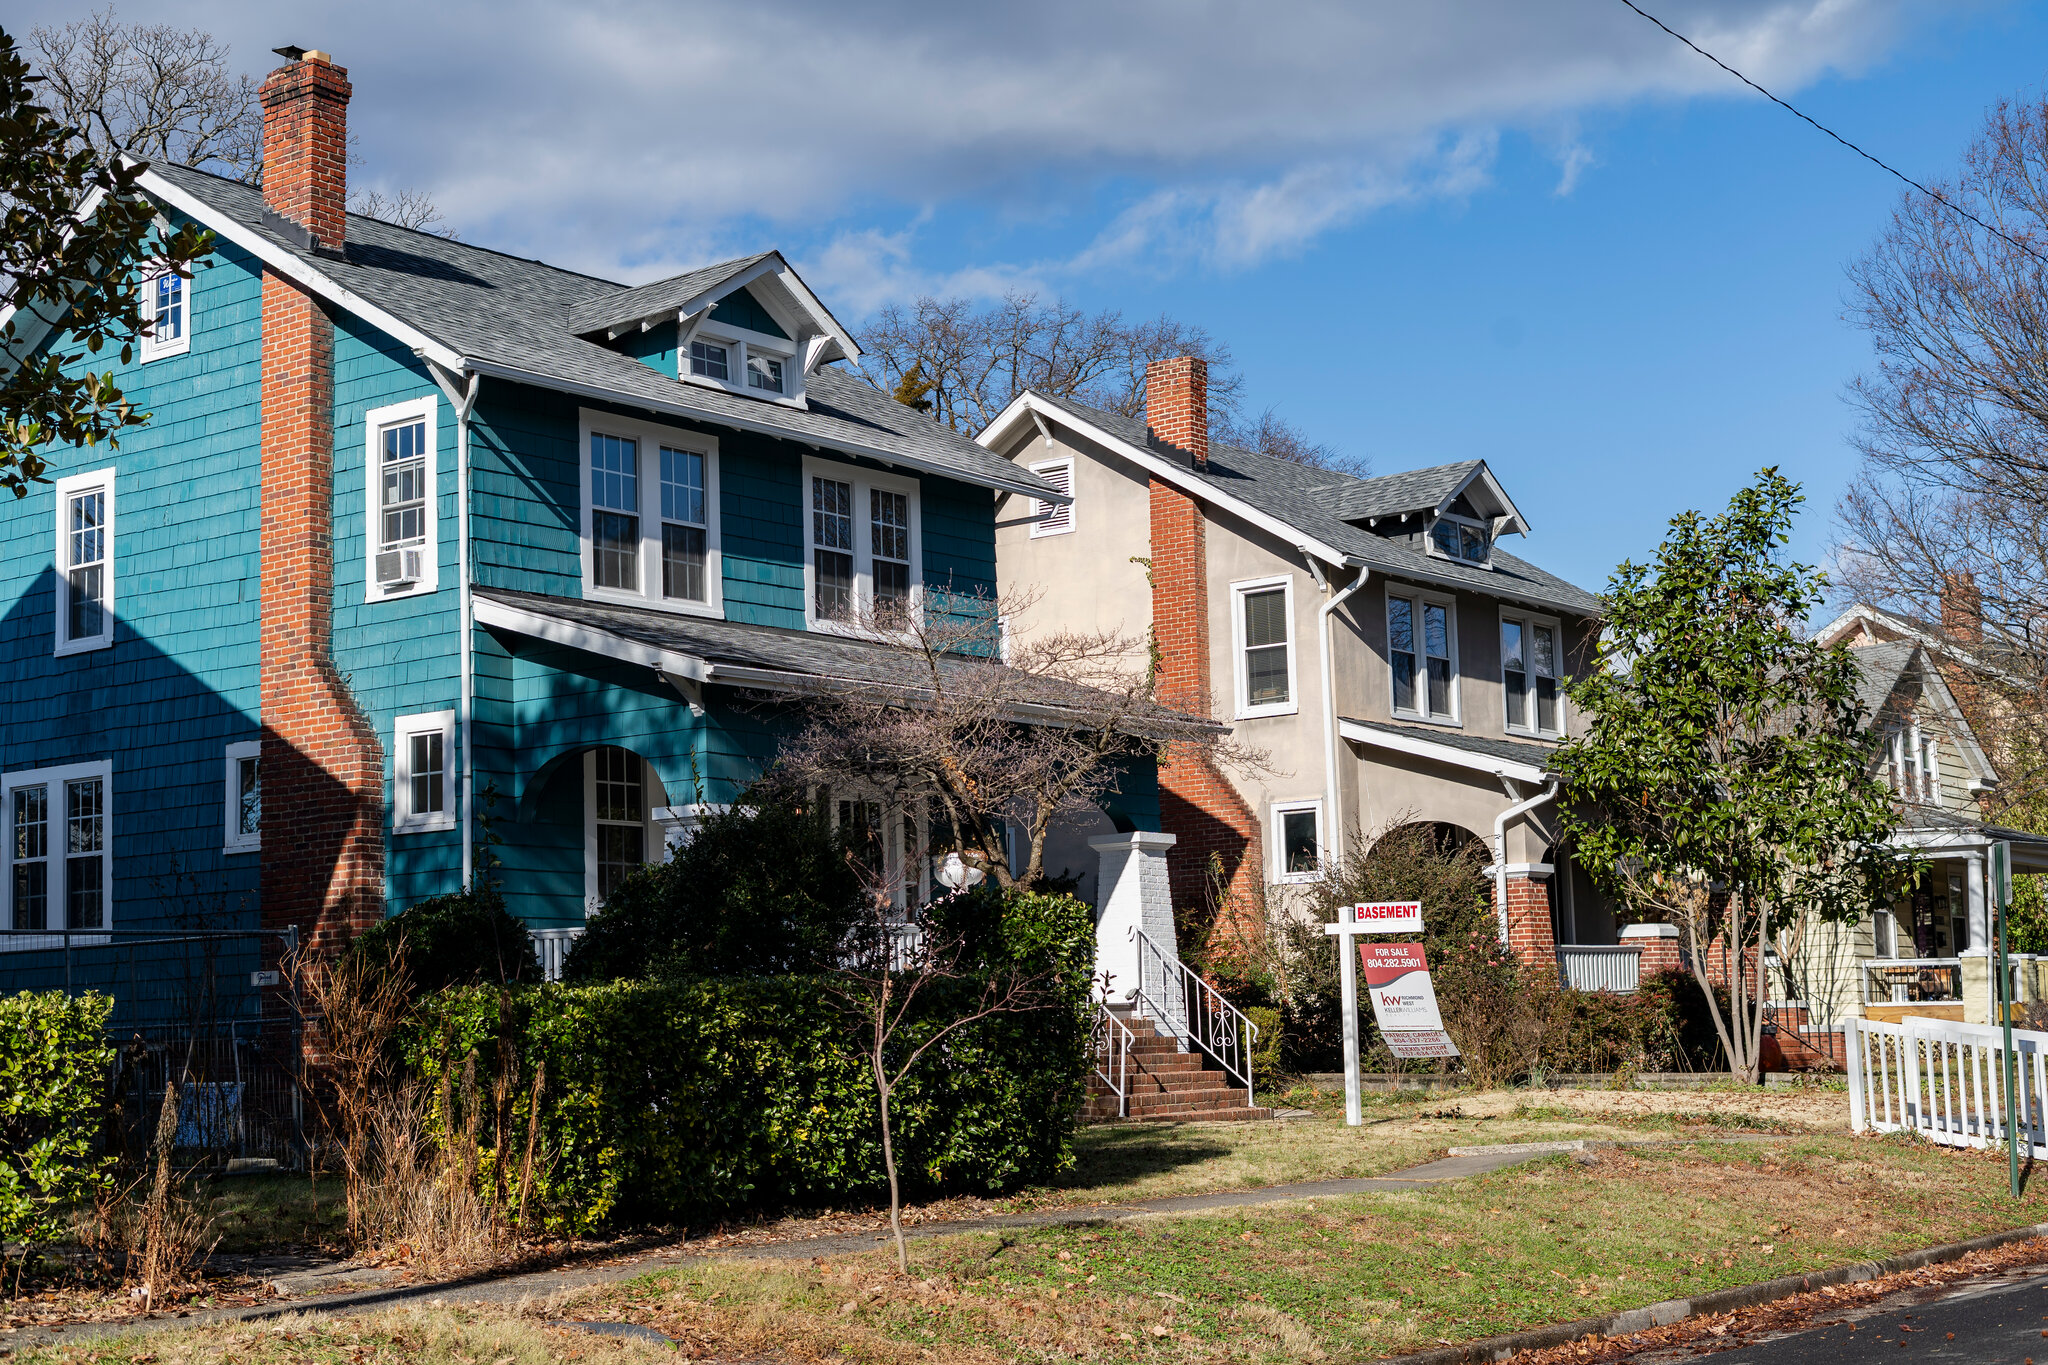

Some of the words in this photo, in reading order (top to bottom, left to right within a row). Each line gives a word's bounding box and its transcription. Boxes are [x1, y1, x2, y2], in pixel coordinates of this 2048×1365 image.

[1357, 905, 1418, 919] BASEMENT
[1375, 948, 1390, 956] FOR
[1390, 948, 1409, 956] SALE
[1367, 958, 1421, 968] 804.282.5901
[1380, 991, 1401, 1006] kw
